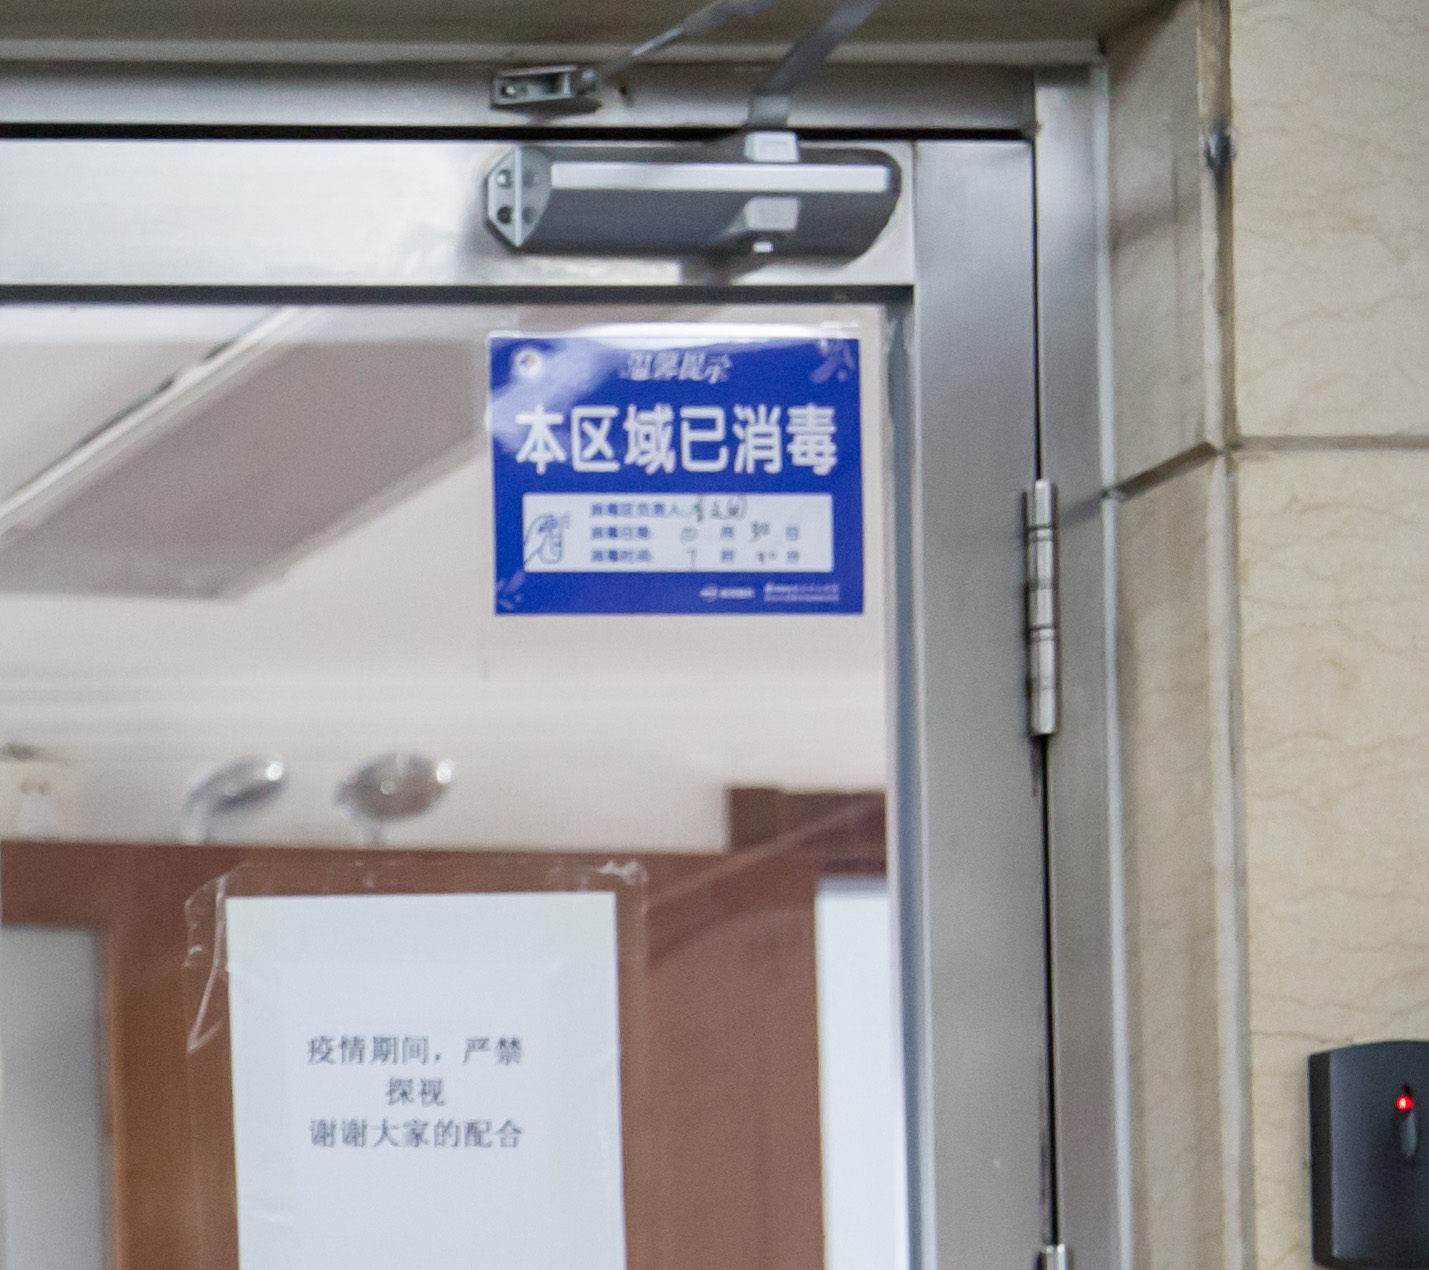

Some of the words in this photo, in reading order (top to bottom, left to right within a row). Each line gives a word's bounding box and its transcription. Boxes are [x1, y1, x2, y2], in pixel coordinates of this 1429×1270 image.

[515, 403, 838, 476] 本区域已消毒
[385, 1077, 446, 1107] 探视
[310, 1118, 523, 1149] 谢谢大家的配合
